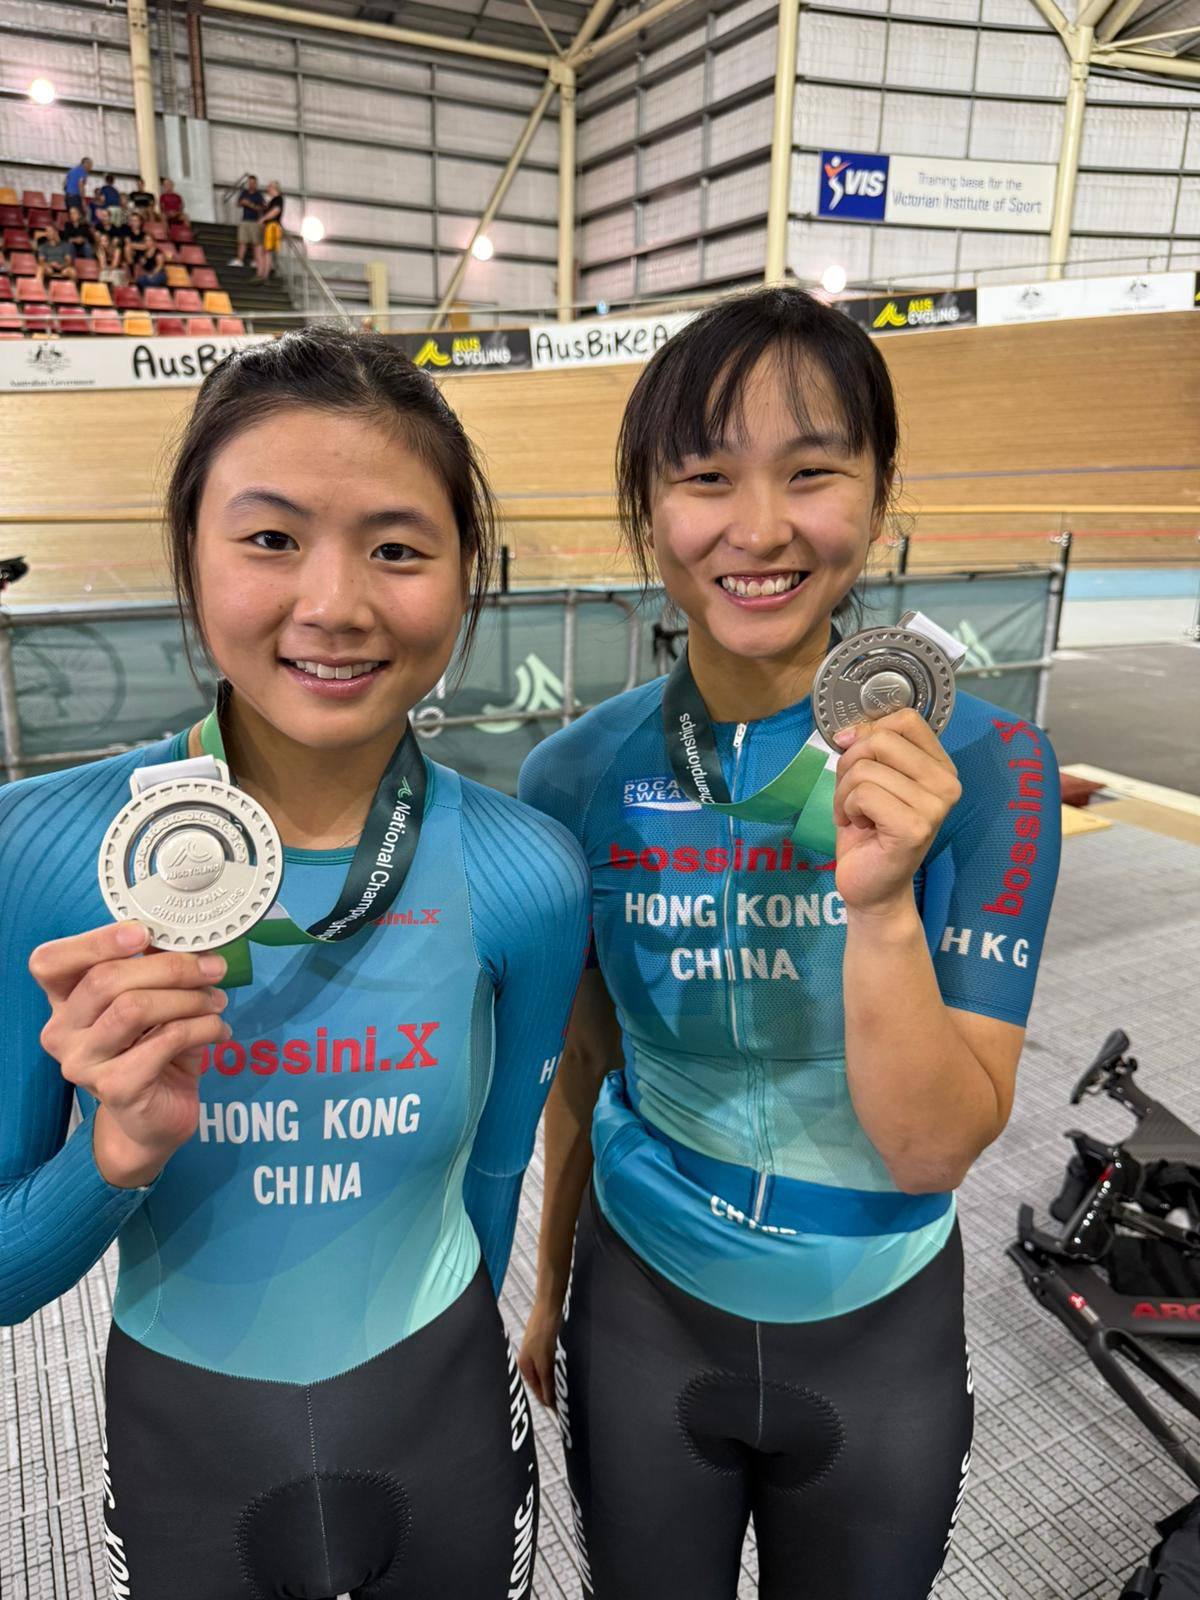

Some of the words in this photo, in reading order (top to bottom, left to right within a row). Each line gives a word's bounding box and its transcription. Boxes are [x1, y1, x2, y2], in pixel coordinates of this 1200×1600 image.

[845, 169, 885, 197] VIS
[918, 172, 957, 190] Training
[960, 176, 984, 189] base
[987, 177, 1002, 189] for
[1006, 178, 1023, 191] the
[892, 190, 939, 208] Victorian
[943, 192, 989, 211] Institute
[993, 196, 1006, 211] of
[1008, 197, 1042, 214] Sport
[908, 307, 960, 325] CYCLING
[453, 348, 511, 365] CYCLING
[623, 780, 680, 794] POCA
[623, 789, 684, 804] SWEA
[981, 719, 1044, 917] bossini.X
[376, 800, 412, 869] National
[151, 887, 245, 924] CHAMPIONSHIPS
[165, 887, 228, 908] NATIONAL
[625, 892, 717, 926] HONG
[737, 891, 848, 927] KONG
[671, 947, 799, 981] CHINA
[199, 1099, 299, 1144] HONG
[323, 1093, 421, 1140] KONG
[253, 1161, 362, 1205] CHINA
